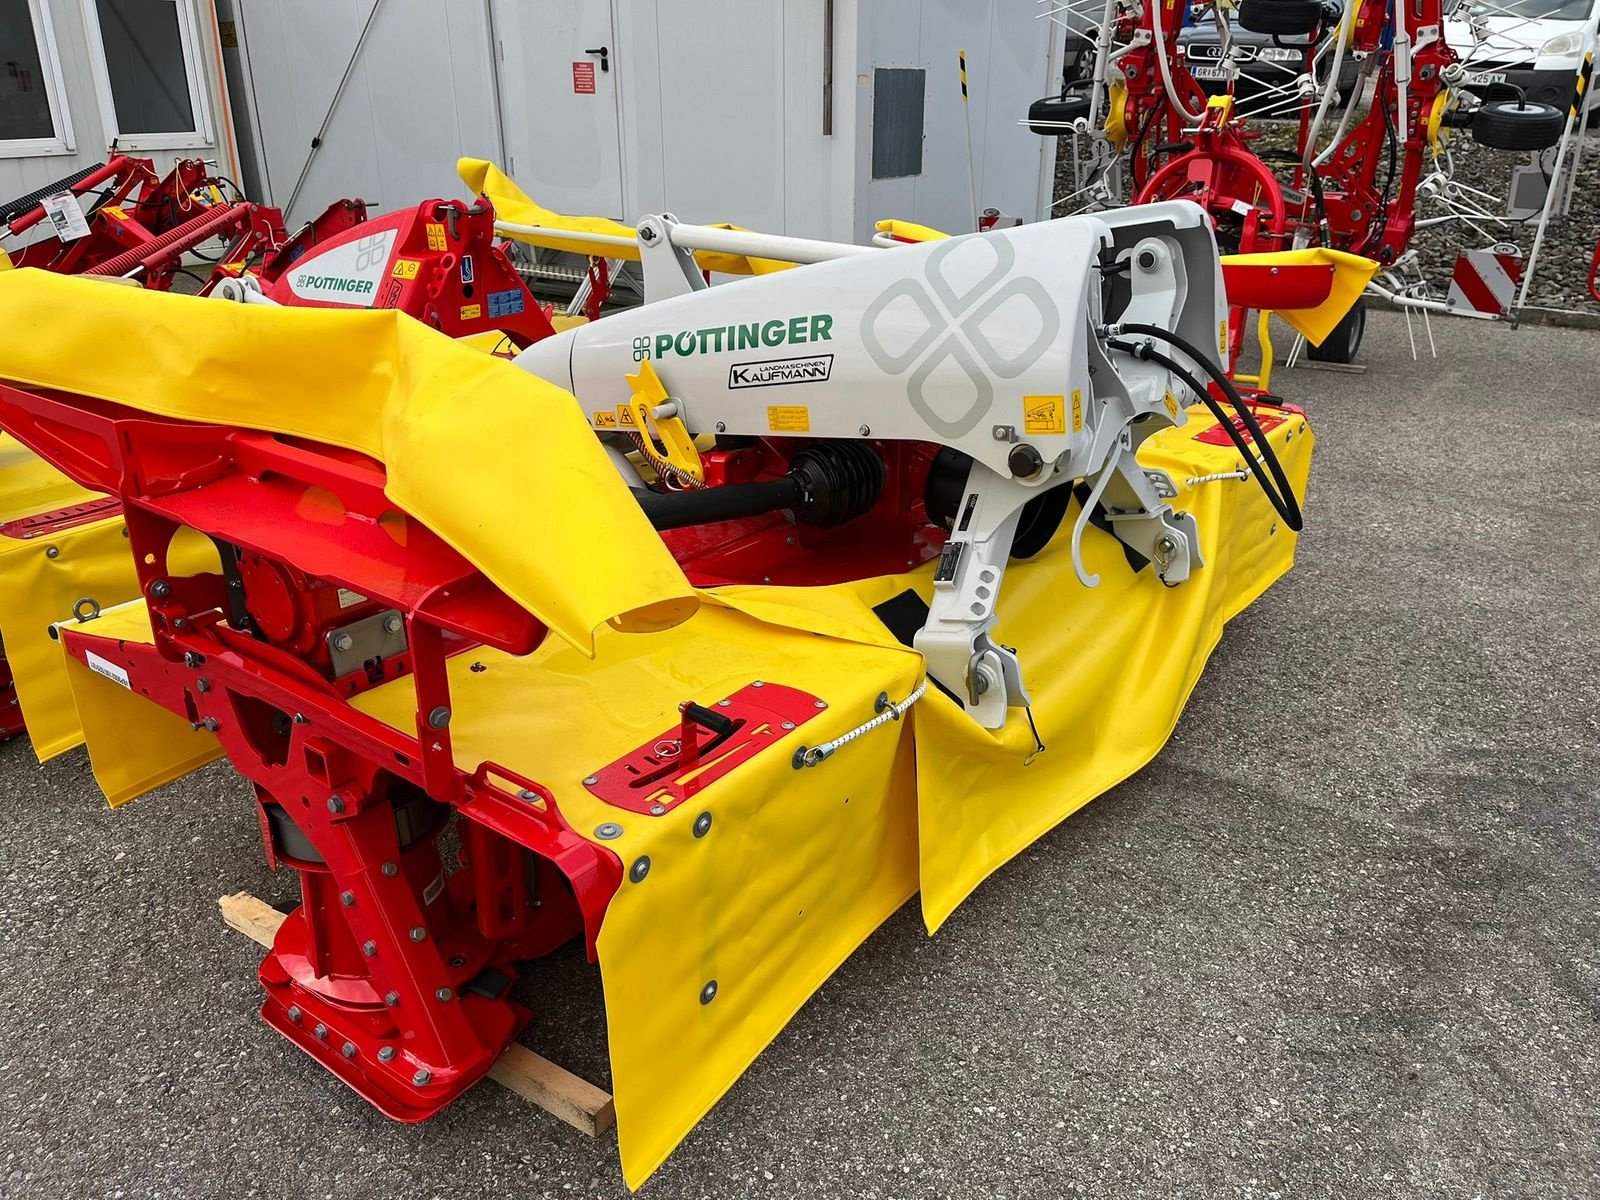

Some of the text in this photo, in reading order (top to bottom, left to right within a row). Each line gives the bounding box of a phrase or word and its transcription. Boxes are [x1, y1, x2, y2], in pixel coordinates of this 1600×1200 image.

[305, 275, 373, 294] PÖTTINGER
[655, 314, 833, 359] PÖTTINGER
[733, 366, 826, 385] KAUFMANN
[759, 360, 826, 372] LANDMASCHINEN
